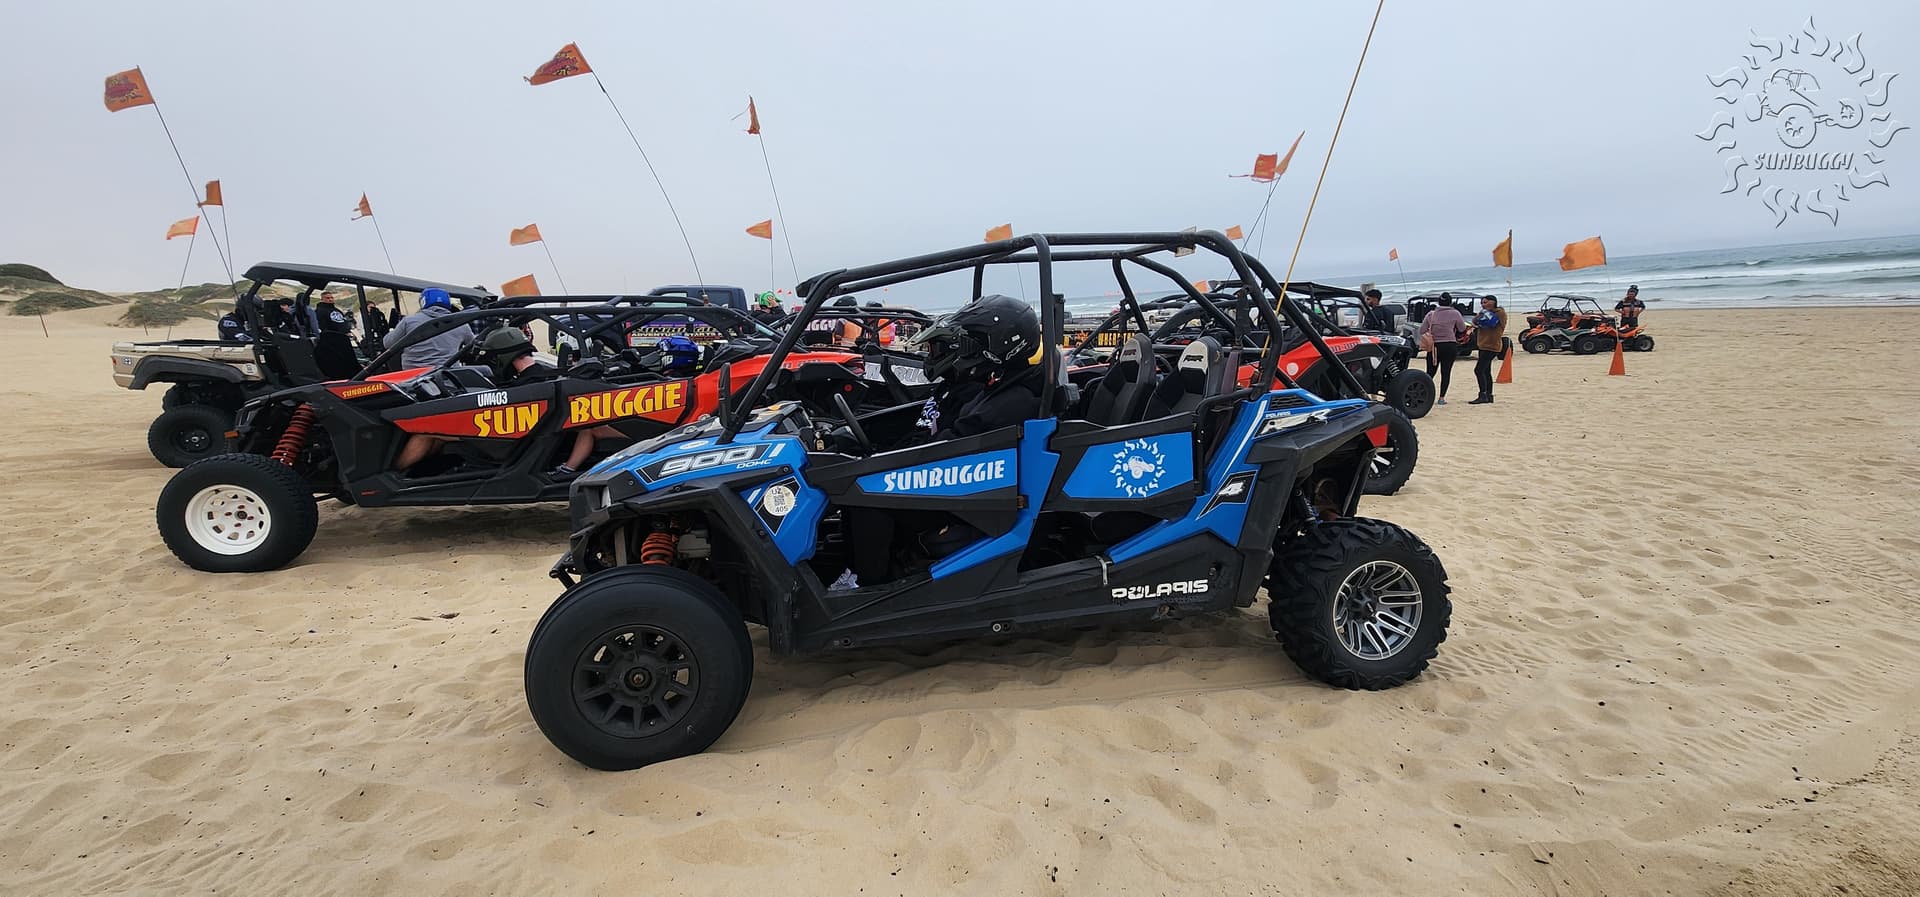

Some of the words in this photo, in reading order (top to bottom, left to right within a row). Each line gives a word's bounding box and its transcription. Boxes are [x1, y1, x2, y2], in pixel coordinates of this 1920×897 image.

[342, 383, 384, 398] SUNBUGGIE
[477, 391, 508, 407] UM403
[474, 403, 539, 437] SUN
[570, 383, 681, 424] BUGGIE
[658, 445, 757, 478] 900
[736, 459, 772, 469] DOHC
[883, 460, 1006, 492] SUNBUGGIE
[1112, 579, 1208, 600] POLARIS
